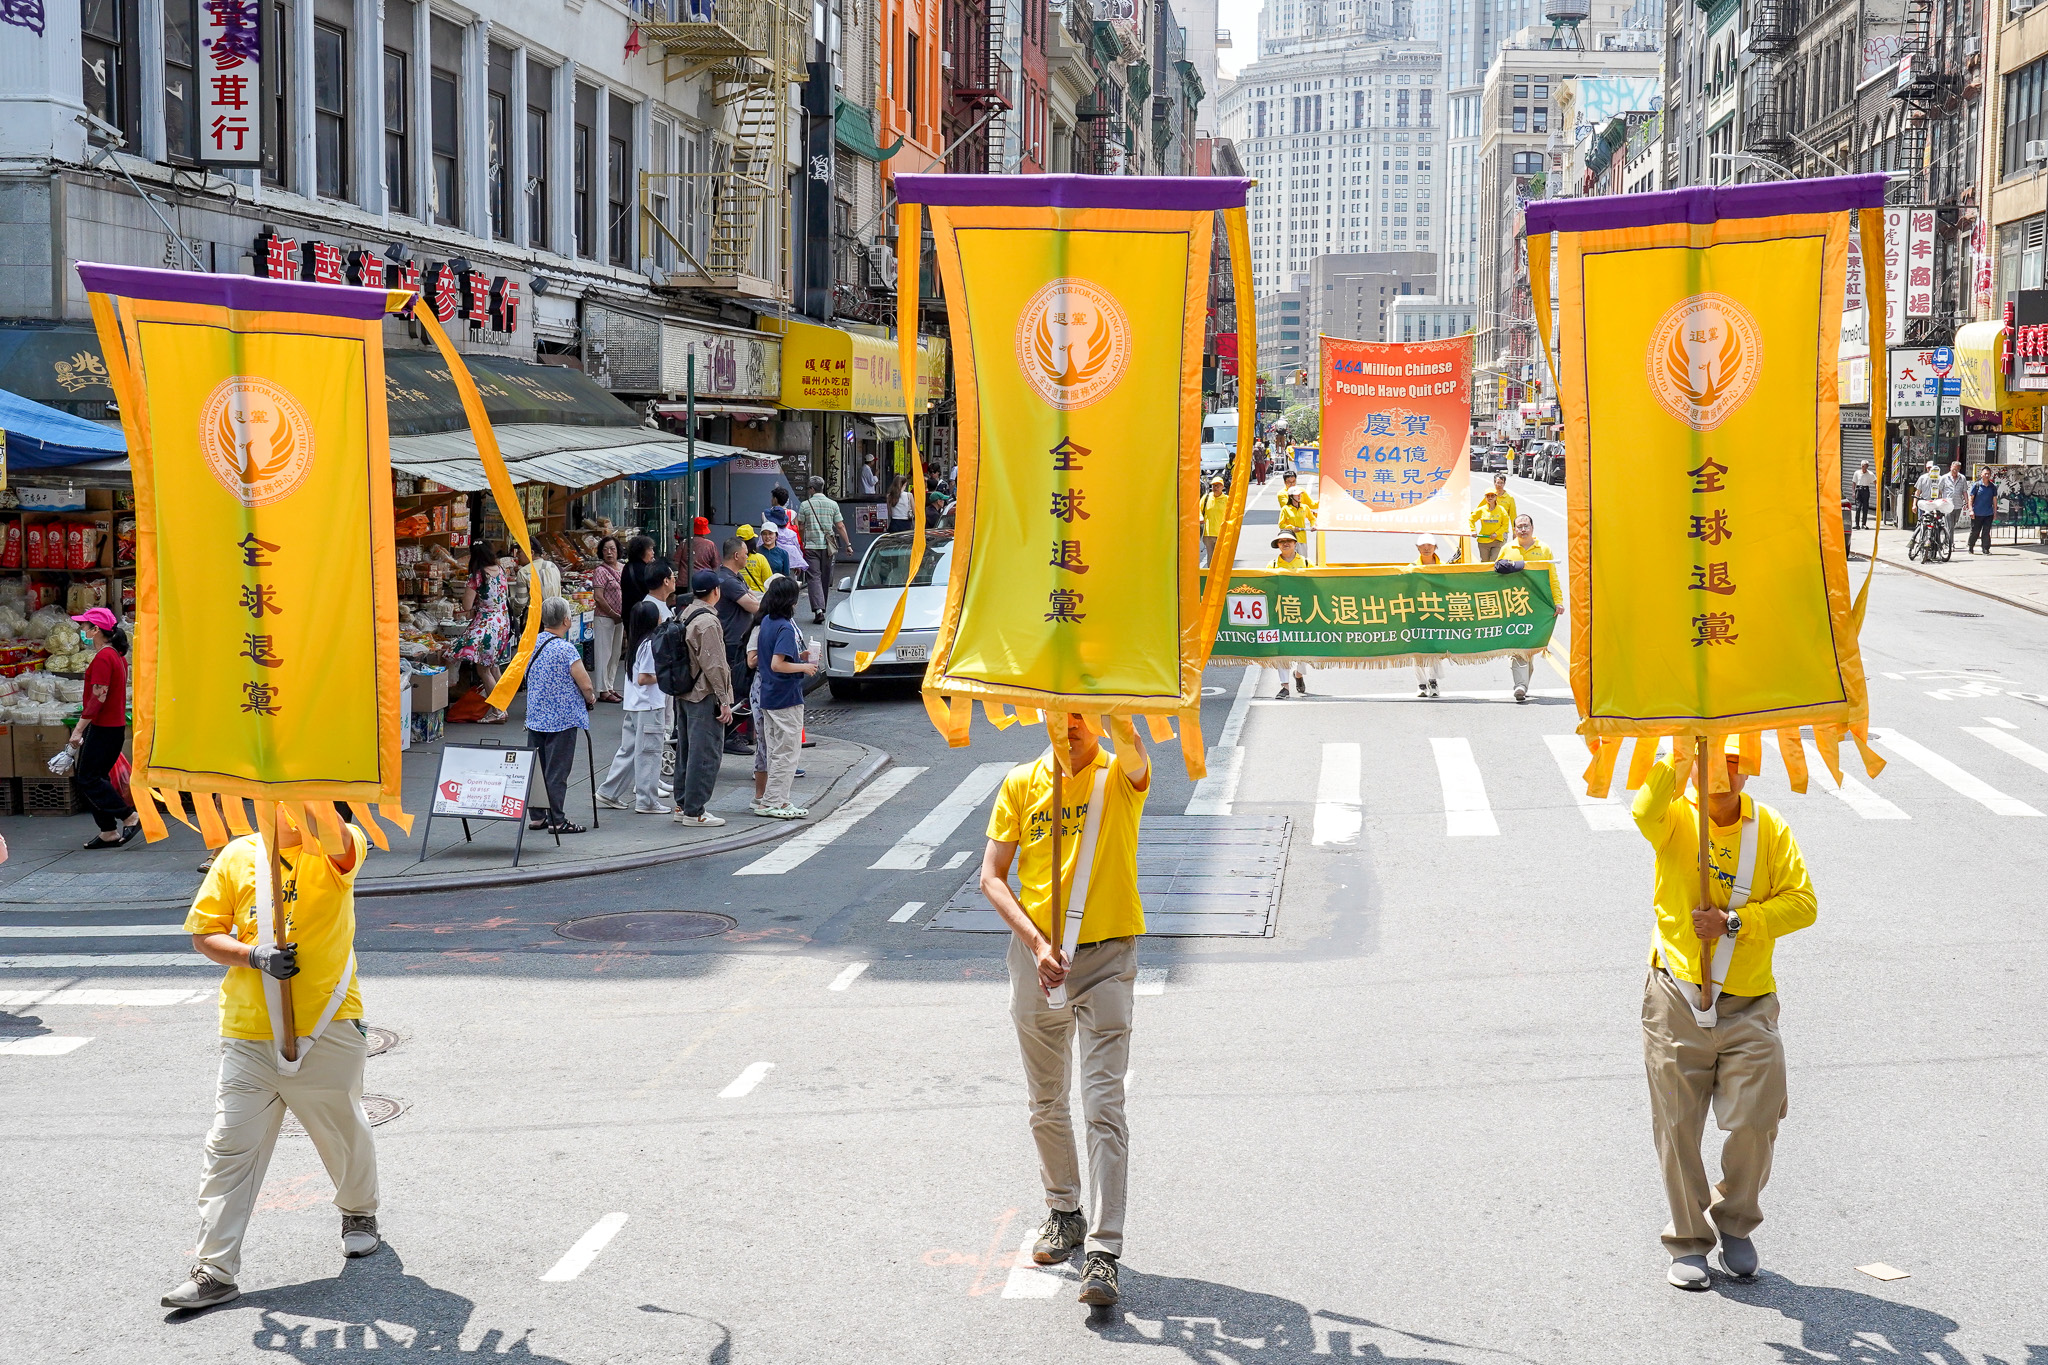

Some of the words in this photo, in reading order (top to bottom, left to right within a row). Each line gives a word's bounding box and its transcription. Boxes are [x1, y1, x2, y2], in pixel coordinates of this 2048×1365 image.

[1680, 302, 1708, 319] CENTER
[1709, 302, 1721, 311] FOR
[1053, 312, 1087, 326] 退黨
[1721, 306, 1752, 345] QUITTING
[1025, 298, 1047, 334] SERVICE
[1074, 287, 1091, 298] FOR
[1091, 294, 1121, 332] QUITTING
[1111, 351, 1121, 372] CCP
[1657, 315, 1680, 354] SERVICE
[1746, 345, 1754, 364] THE
[1405, 361, 1453, 376] Chinese
[1656, 355, 1669, 392] GLOBAL
[1742, 365, 1752, 384] CCP
[226, 385, 250, 396] CETER
[253, 385, 271, 397] FOR
[801, 375, 850, 388] 福州小吃店
[1336, 380, 1376, 397] People
[1378, 384, 1407, 397] Have
[1409, 384, 1433, 398] Quit
[1434, 380, 1457, 396] CCP
[209, 393, 228, 427] SERVICE
[271, 393, 303, 431] QUITTING
[1363, 413, 1431, 437] 慶賀
[208, 423, 220, 463] GLOBAL
[296, 452, 306, 470] CCP
[1357, 445, 1429, 463] 4.64億
[1344, 466, 1452, 485] 中華兒女
[1044, 435, 1093, 624] 全球退黨
[1687, 457, 1739, 648] 全球退黨
[1233, 600, 1263, 620] 4.6
[1274, 588, 1535, 626] 億人退出中共黨團隊
[237, 532, 284, 717] 全球退黨
[1258, 630, 1279, 643] 464
[1281, 630, 1343, 643] MILLION
[1346, 630, 1398, 643] PEOPLE
[1400, 626, 1473, 642] QUITTING
[1475, 625, 1503, 639] THE
[1505, 623, 1534, 636] CCP
[467, 778, 482, 786] Open
[1031, 807, 1071, 826] FALN
